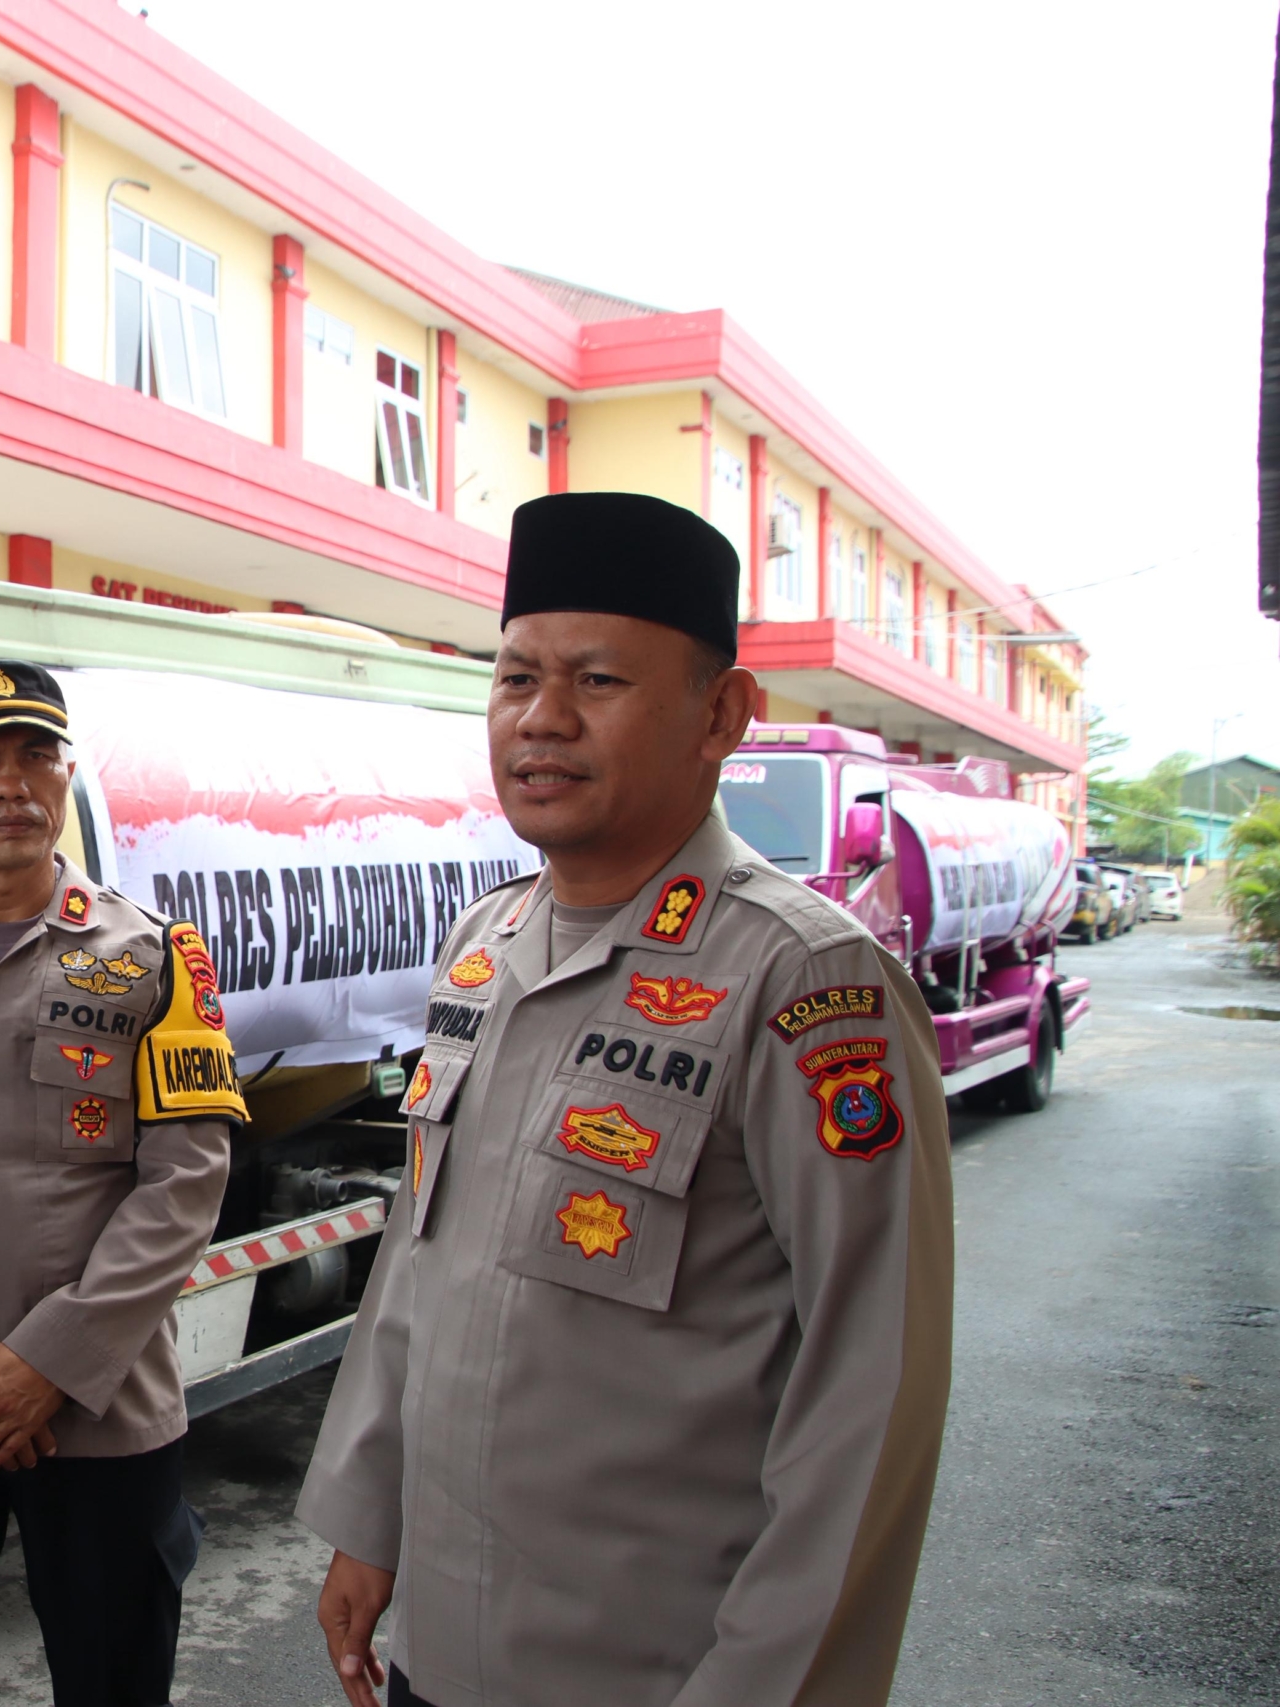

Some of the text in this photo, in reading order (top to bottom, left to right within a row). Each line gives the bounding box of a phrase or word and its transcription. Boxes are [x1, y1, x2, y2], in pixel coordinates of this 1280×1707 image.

[279, 862, 426, 985] PELABUHAN
[49, 1001, 136, 1037] POLRI
[776, 989, 876, 1030] POLRES
[787, 1002, 873, 1035] PELABUHAN BELAWAN
[575, 1033, 712, 1097] POLRI
[805, 1042, 879, 1071] SUMATERA UTARA
[578, 1134, 631, 1157] SNIPER
